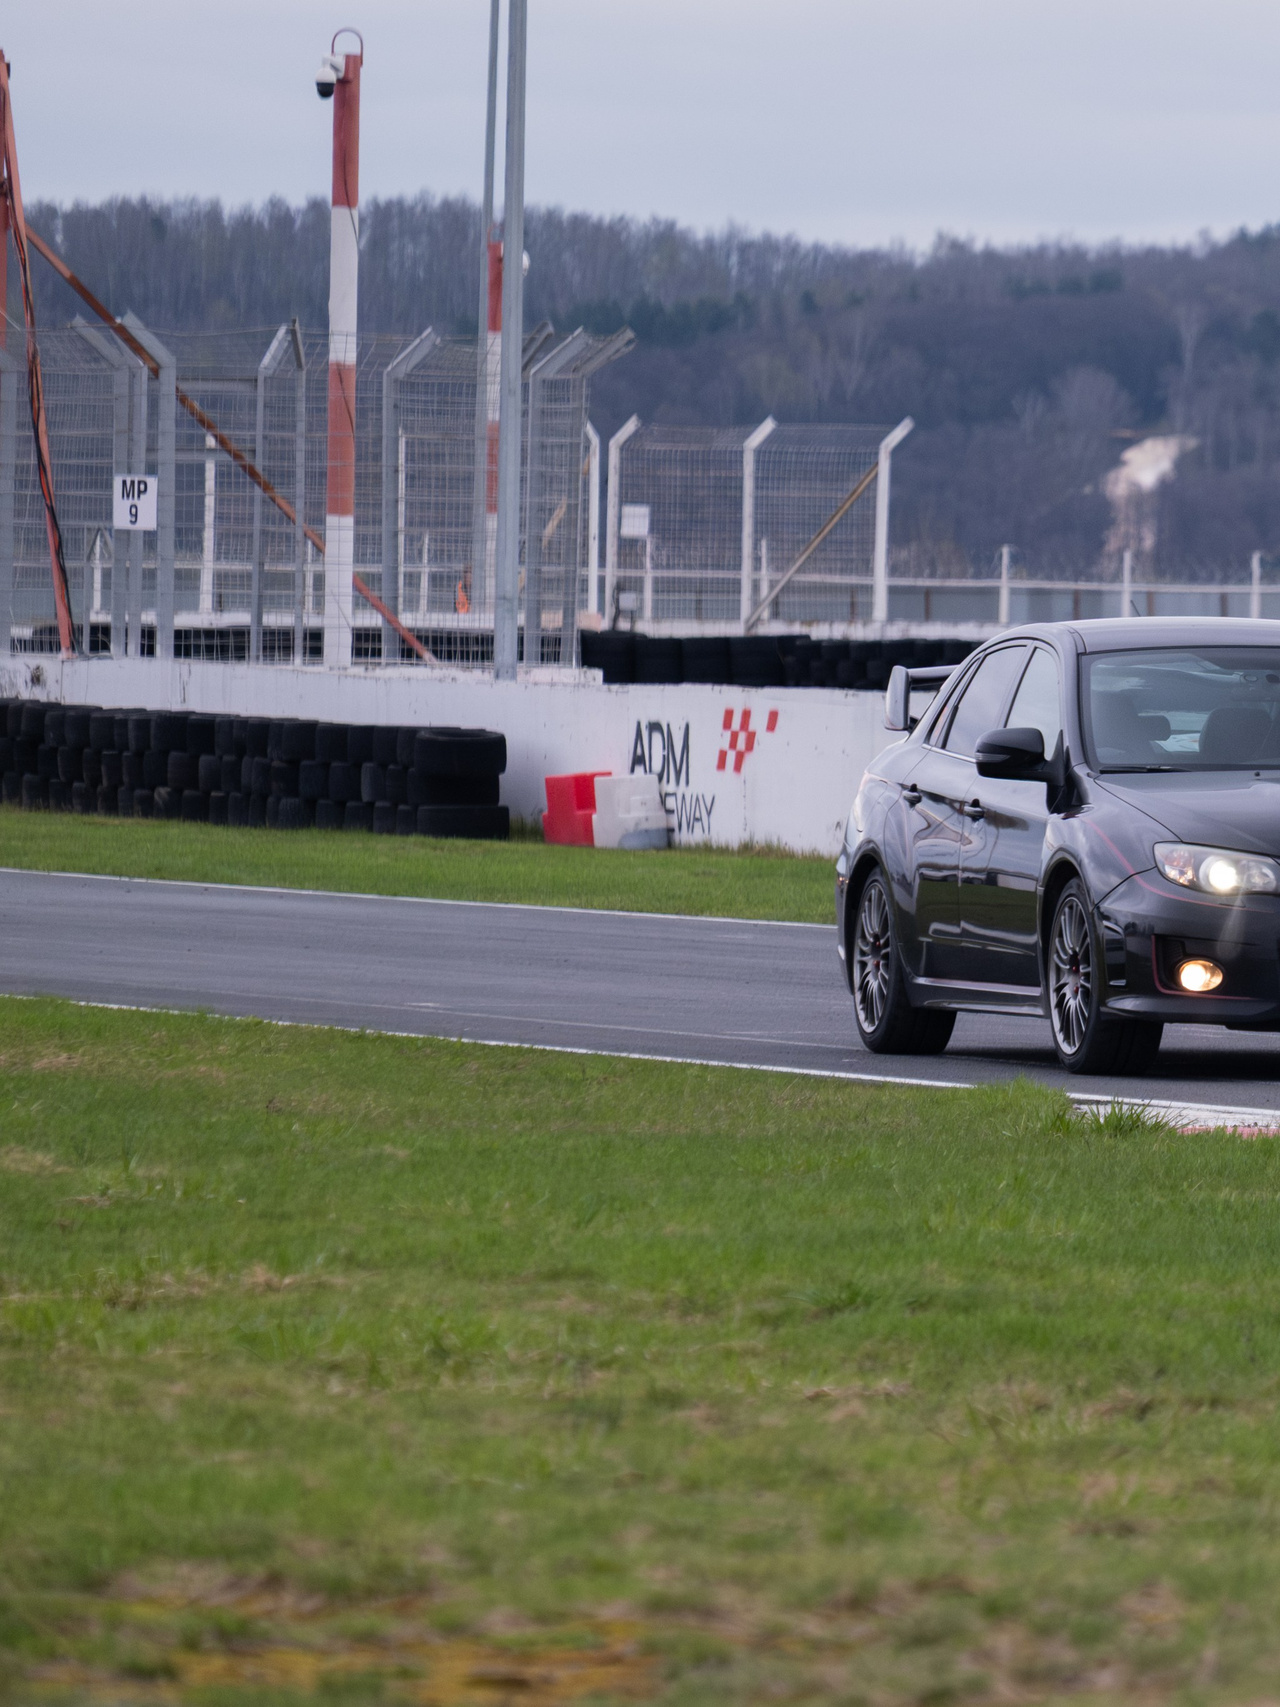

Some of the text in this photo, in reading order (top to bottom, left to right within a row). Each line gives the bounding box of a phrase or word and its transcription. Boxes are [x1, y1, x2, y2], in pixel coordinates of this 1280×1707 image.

[121, 479, 148, 500] MP
[129, 503, 139, 526] 9
[629, 720, 690, 787] ADM
[659, 792, 716, 835] EWAY
